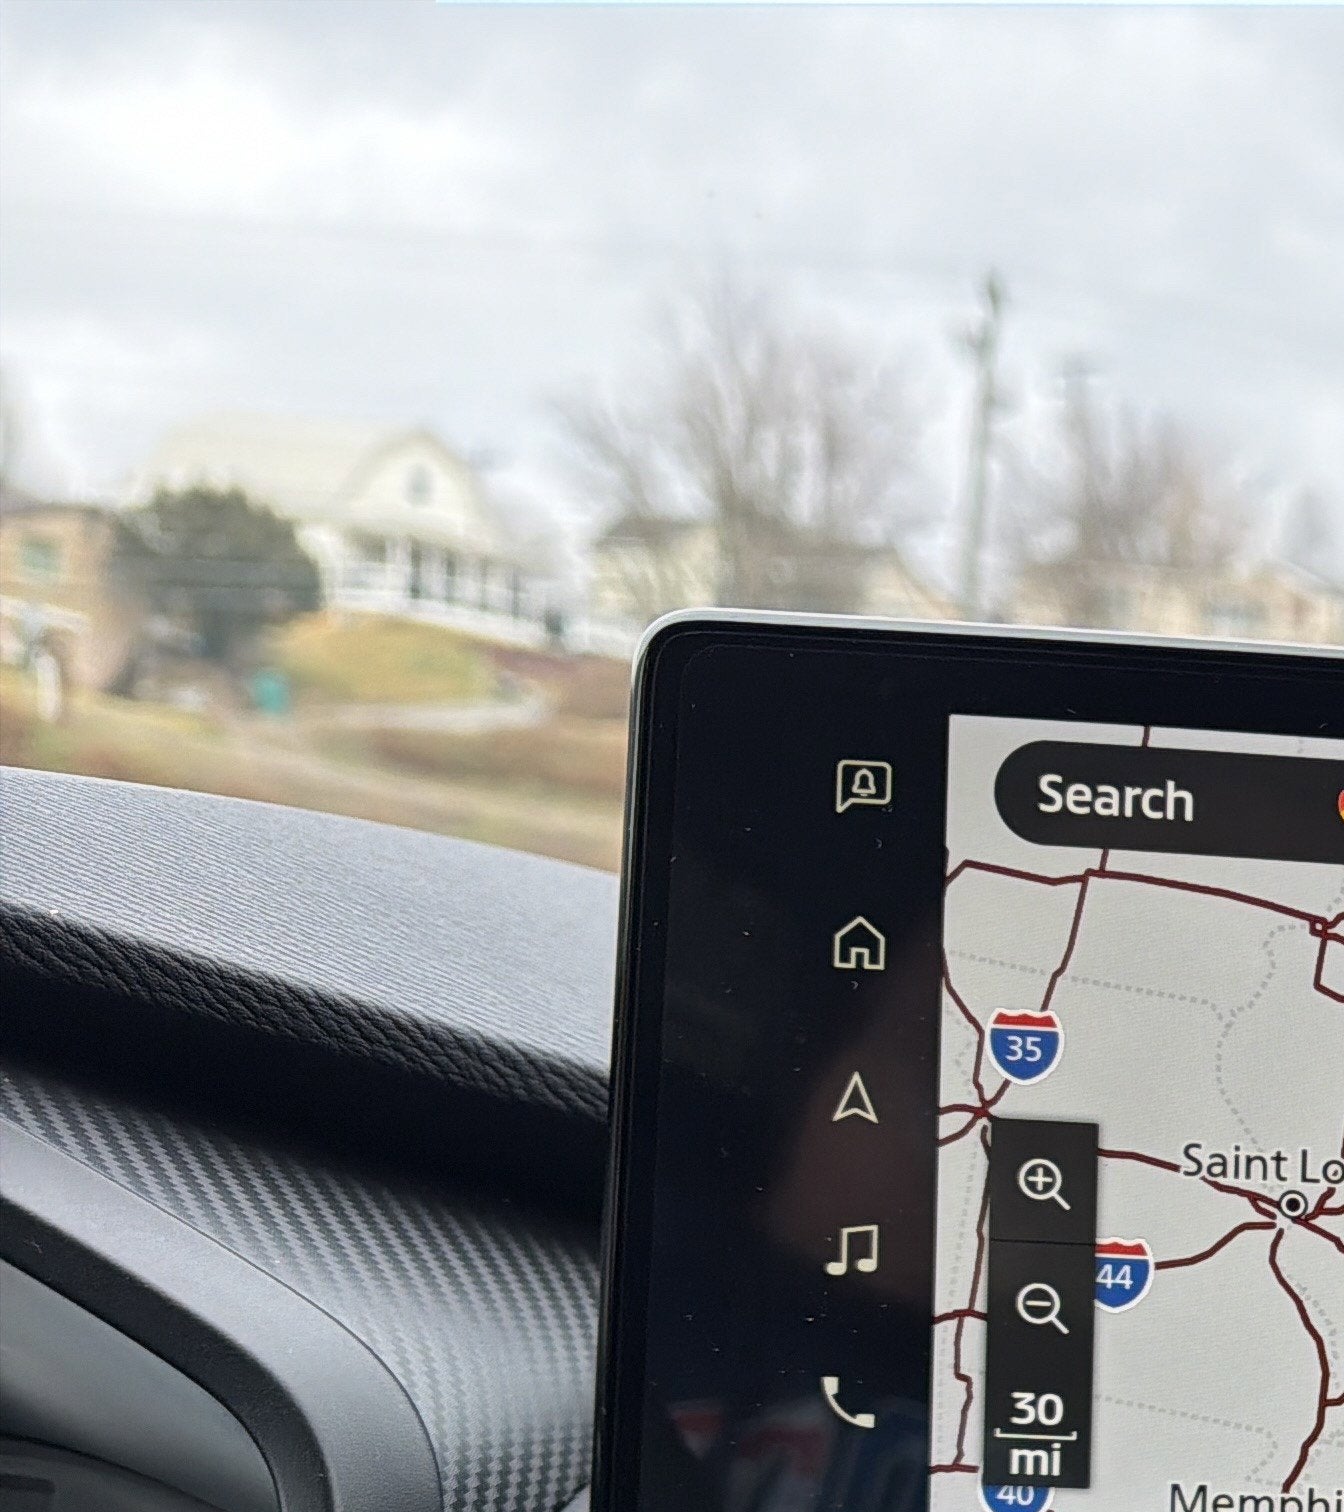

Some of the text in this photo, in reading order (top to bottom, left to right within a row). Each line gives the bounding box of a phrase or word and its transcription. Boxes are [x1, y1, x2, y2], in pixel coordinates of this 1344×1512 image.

[1037, 774, 1195, 822] Search
[1005, 1035, 1043, 1062] 35
[1182, 1145, 1288, 1182] Saint
[1096, 1263, 1133, 1289] 44
[1010, 1393, 1063, 1426] 30
[1010, 1443, 1061, 1477] mi
[996, 1484, 1035, 1506] 40
